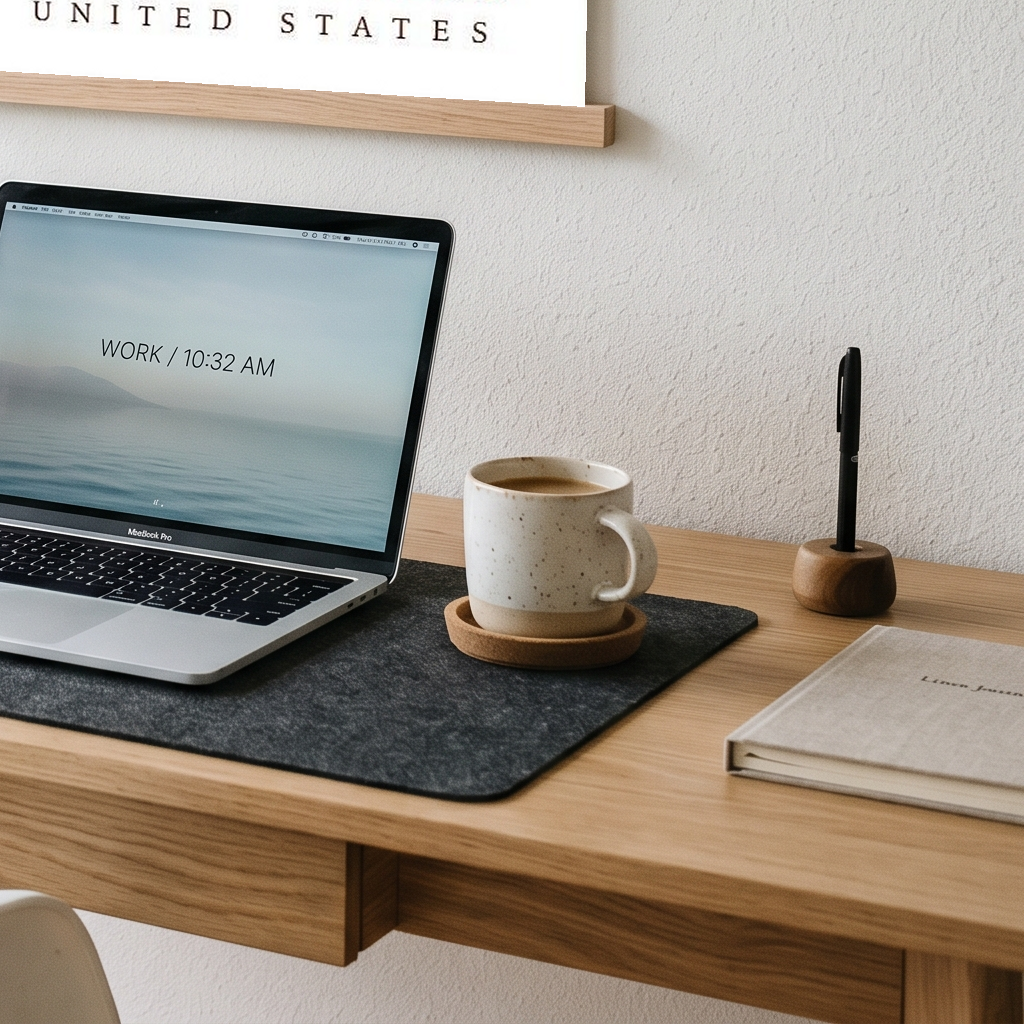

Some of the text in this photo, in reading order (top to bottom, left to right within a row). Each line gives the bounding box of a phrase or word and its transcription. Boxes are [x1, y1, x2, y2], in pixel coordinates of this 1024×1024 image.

[32, 0, 488, 44] UNITED STATES
[101, 338, 276, 378] WORK / 10:32 AM
[160, 532, 173, 542] Pro
